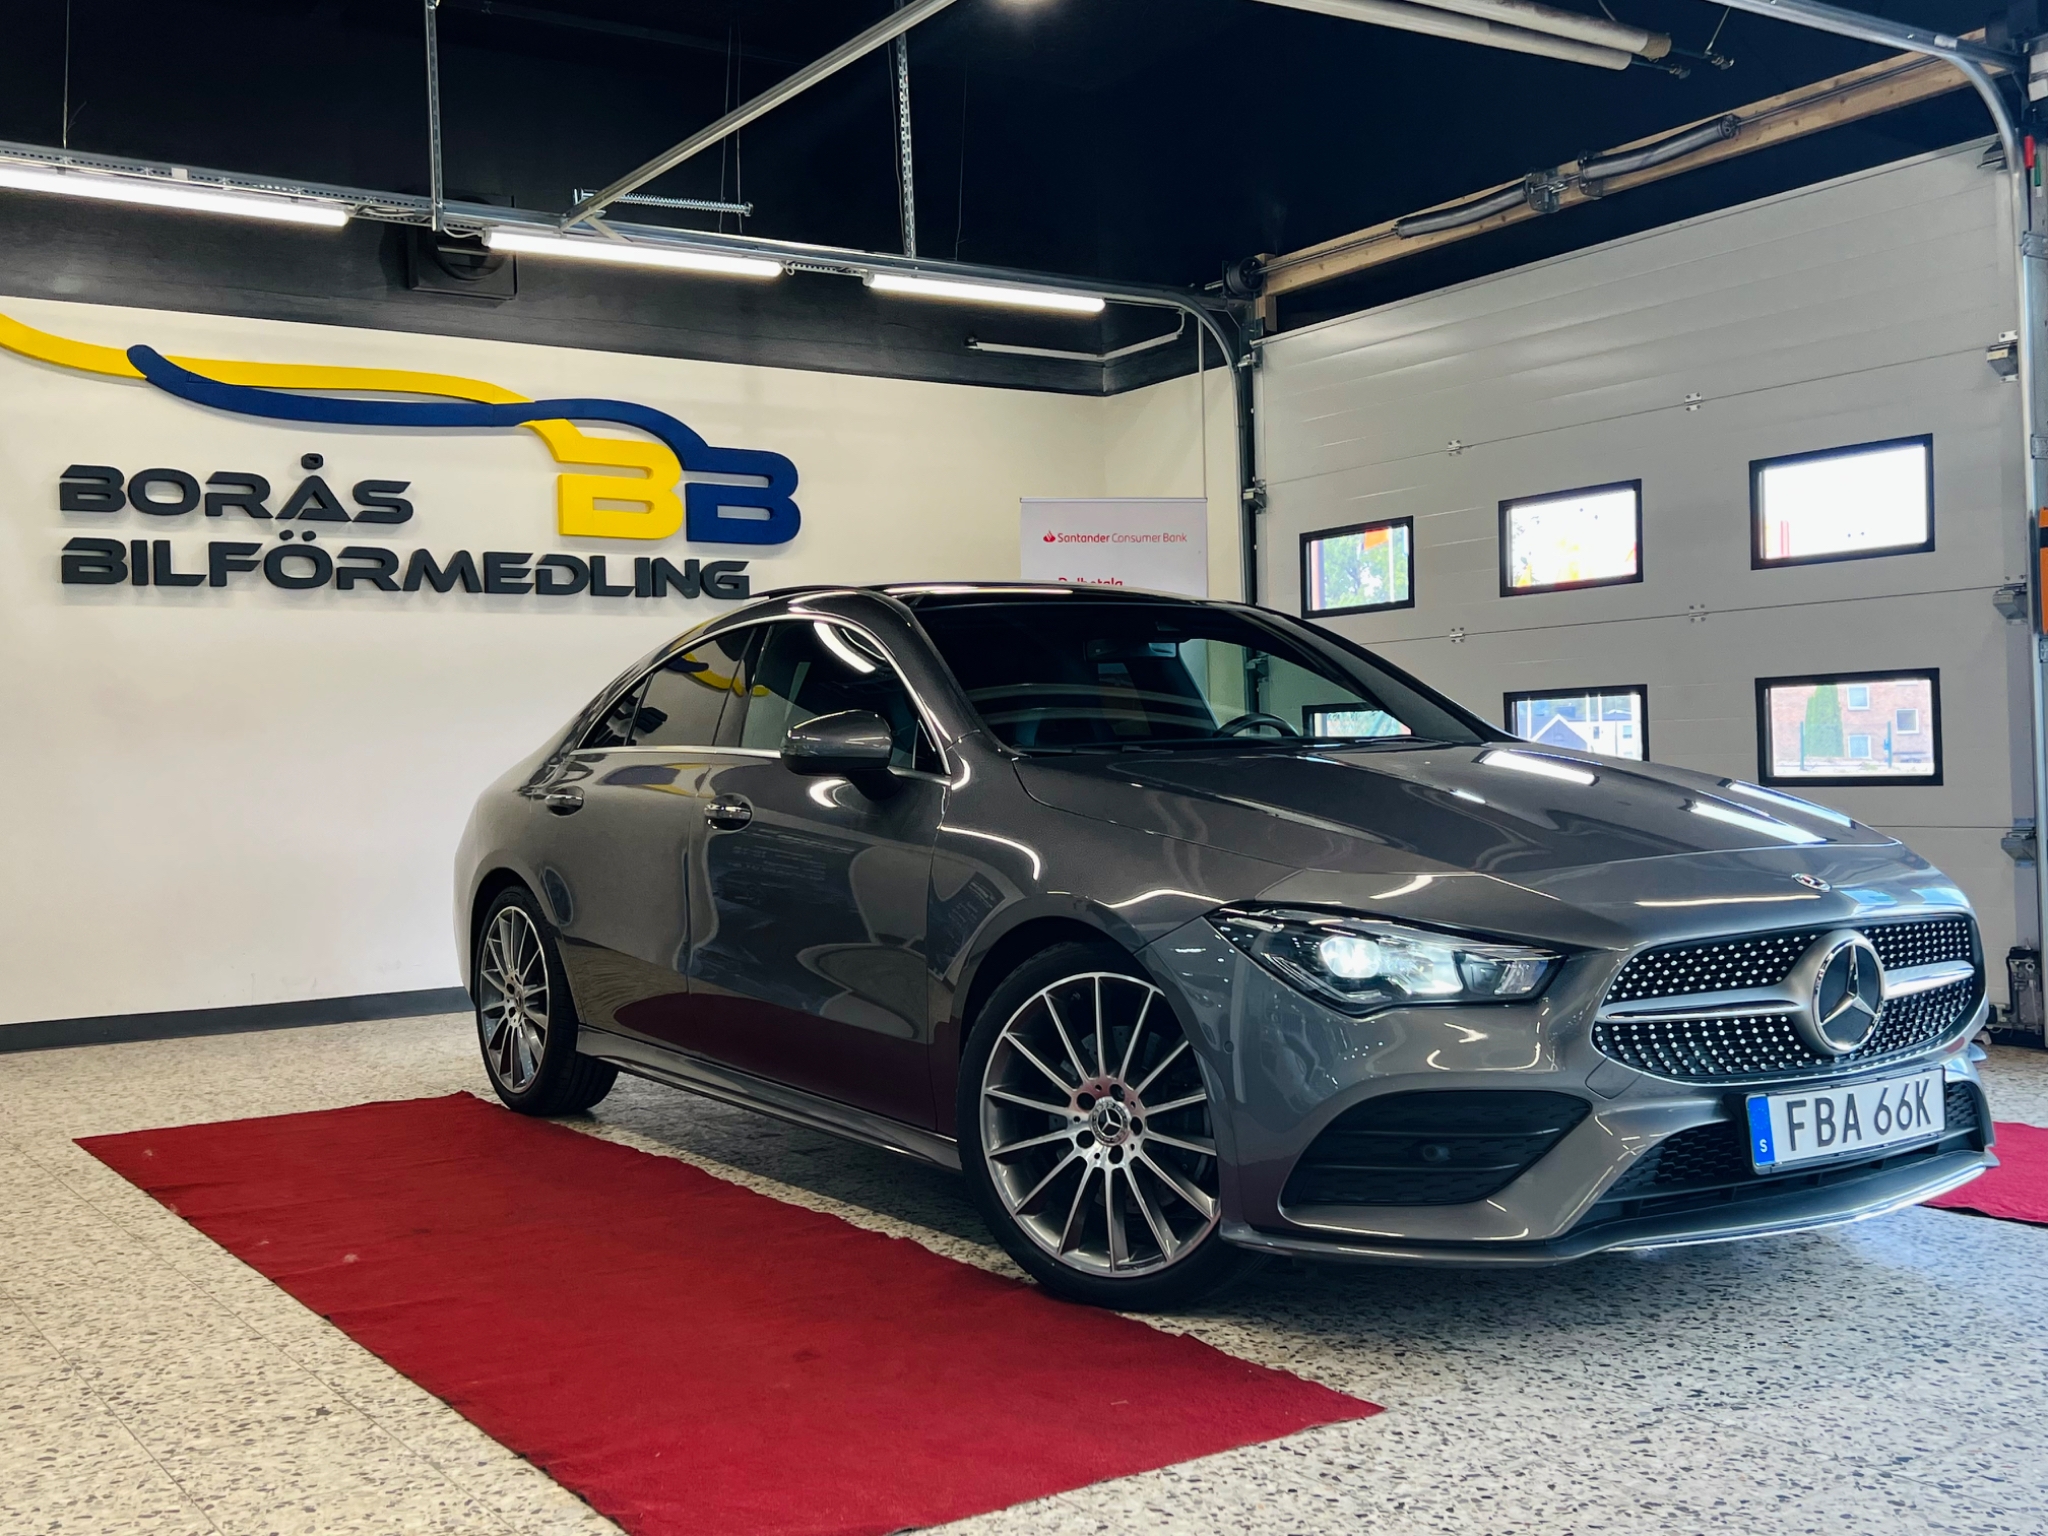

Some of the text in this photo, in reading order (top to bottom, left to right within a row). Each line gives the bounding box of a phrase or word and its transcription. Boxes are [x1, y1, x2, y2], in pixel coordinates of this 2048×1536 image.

[60, 453, 413, 523] BORÅS
[61, 530, 750, 599] BILFÖRMEDLING
[1057, 532, 1188, 543] Santander Consumer Bank
[1759, 1139, 1768, 1153] S
[1786, 1078, 1932, 1151] FBA 66K
